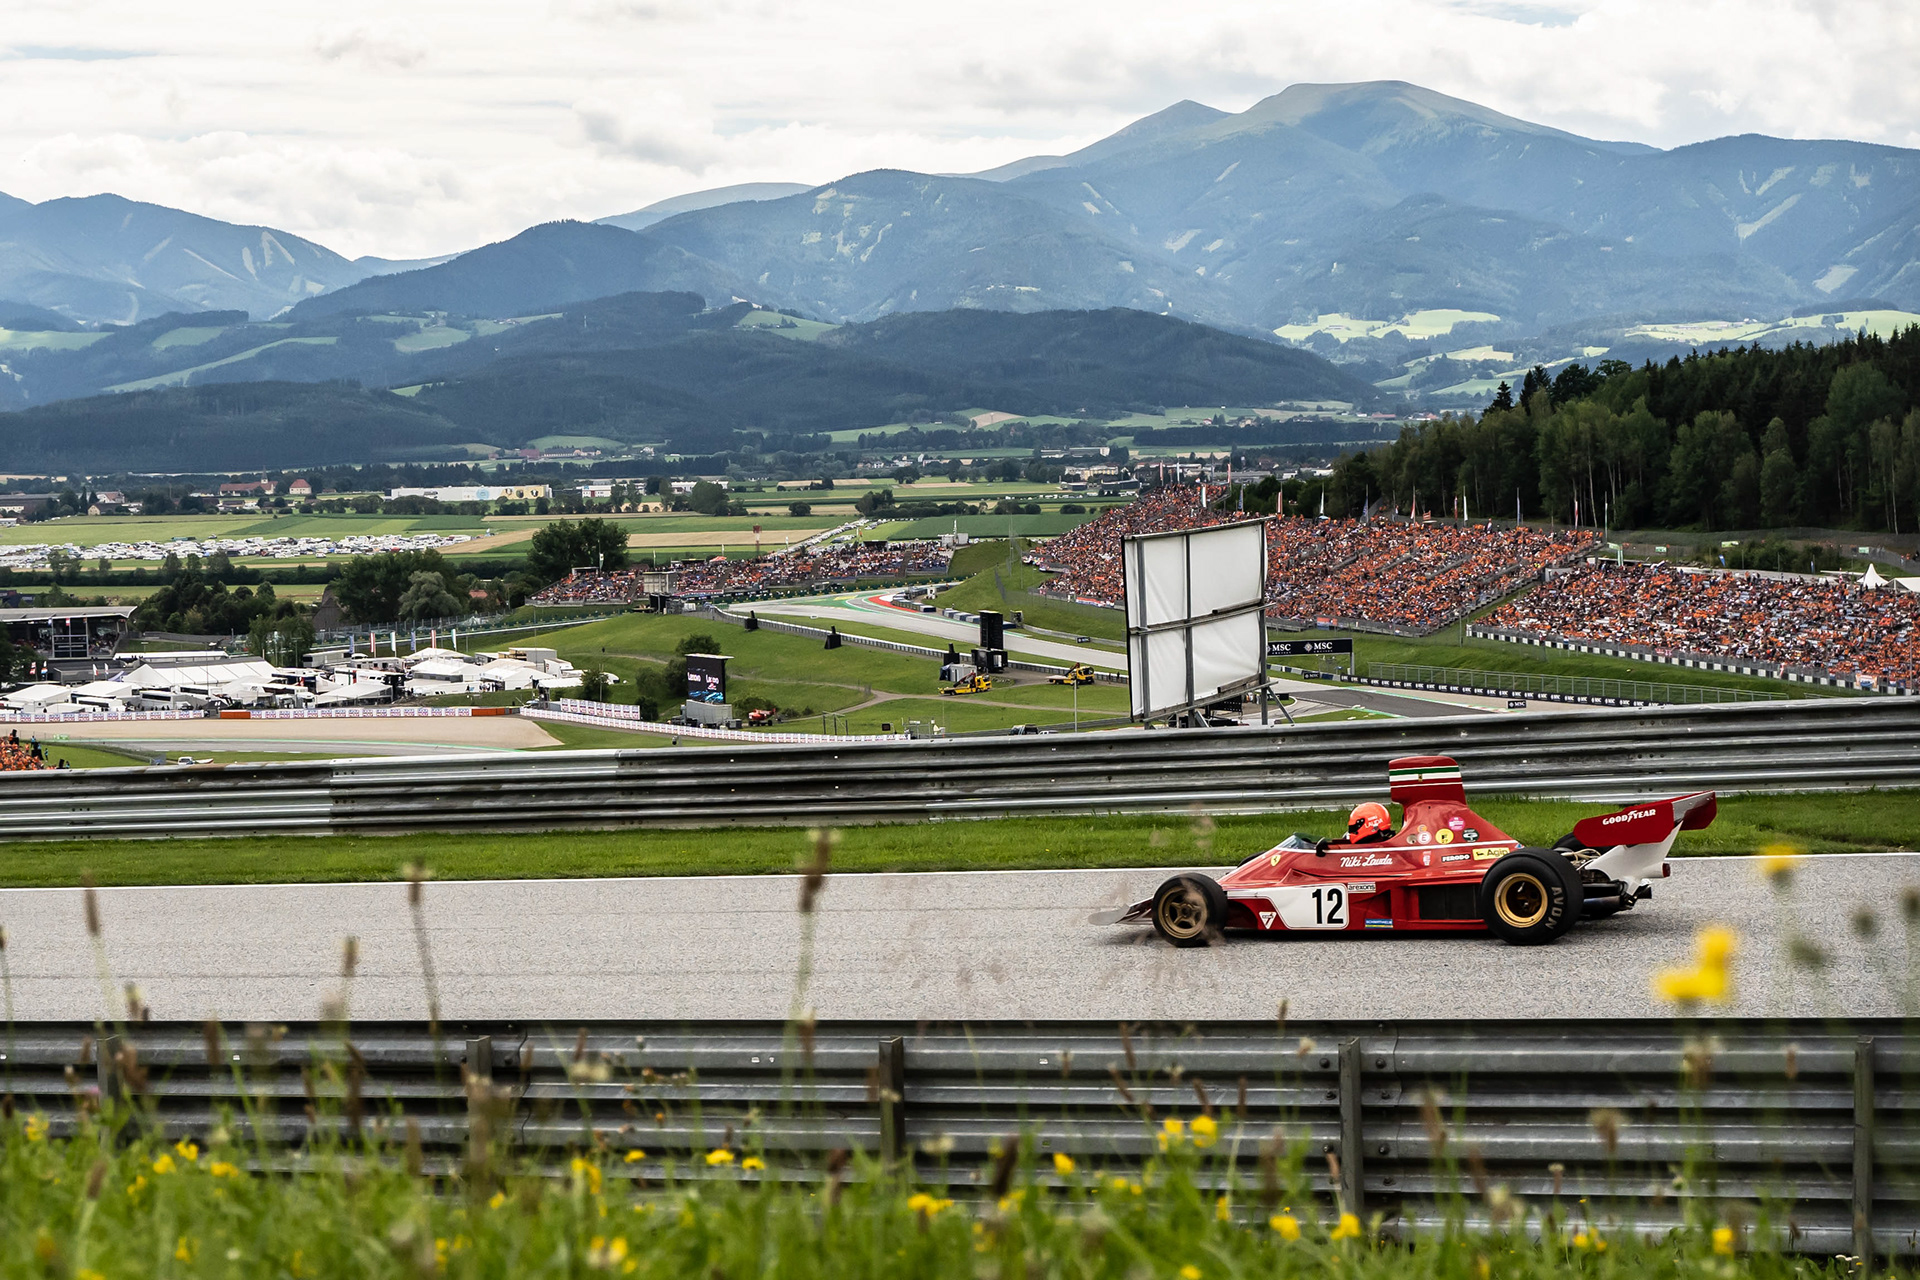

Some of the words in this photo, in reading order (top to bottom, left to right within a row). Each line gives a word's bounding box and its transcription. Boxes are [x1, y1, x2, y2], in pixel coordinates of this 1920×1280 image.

[1314, 642, 1333, 650] MSC
[1602, 809, 1656, 825] GOODYEAR
[1442, 854, 1470, 862] FERODO
[1487, 849, 1508, 857] Agip
[1340, 856, 1362, 867] Niki
[1362, 854, 1393, 866] Lauda
[1312, 888, 1344, 924] 12
[1545, 887, 1564, 929] AVON
